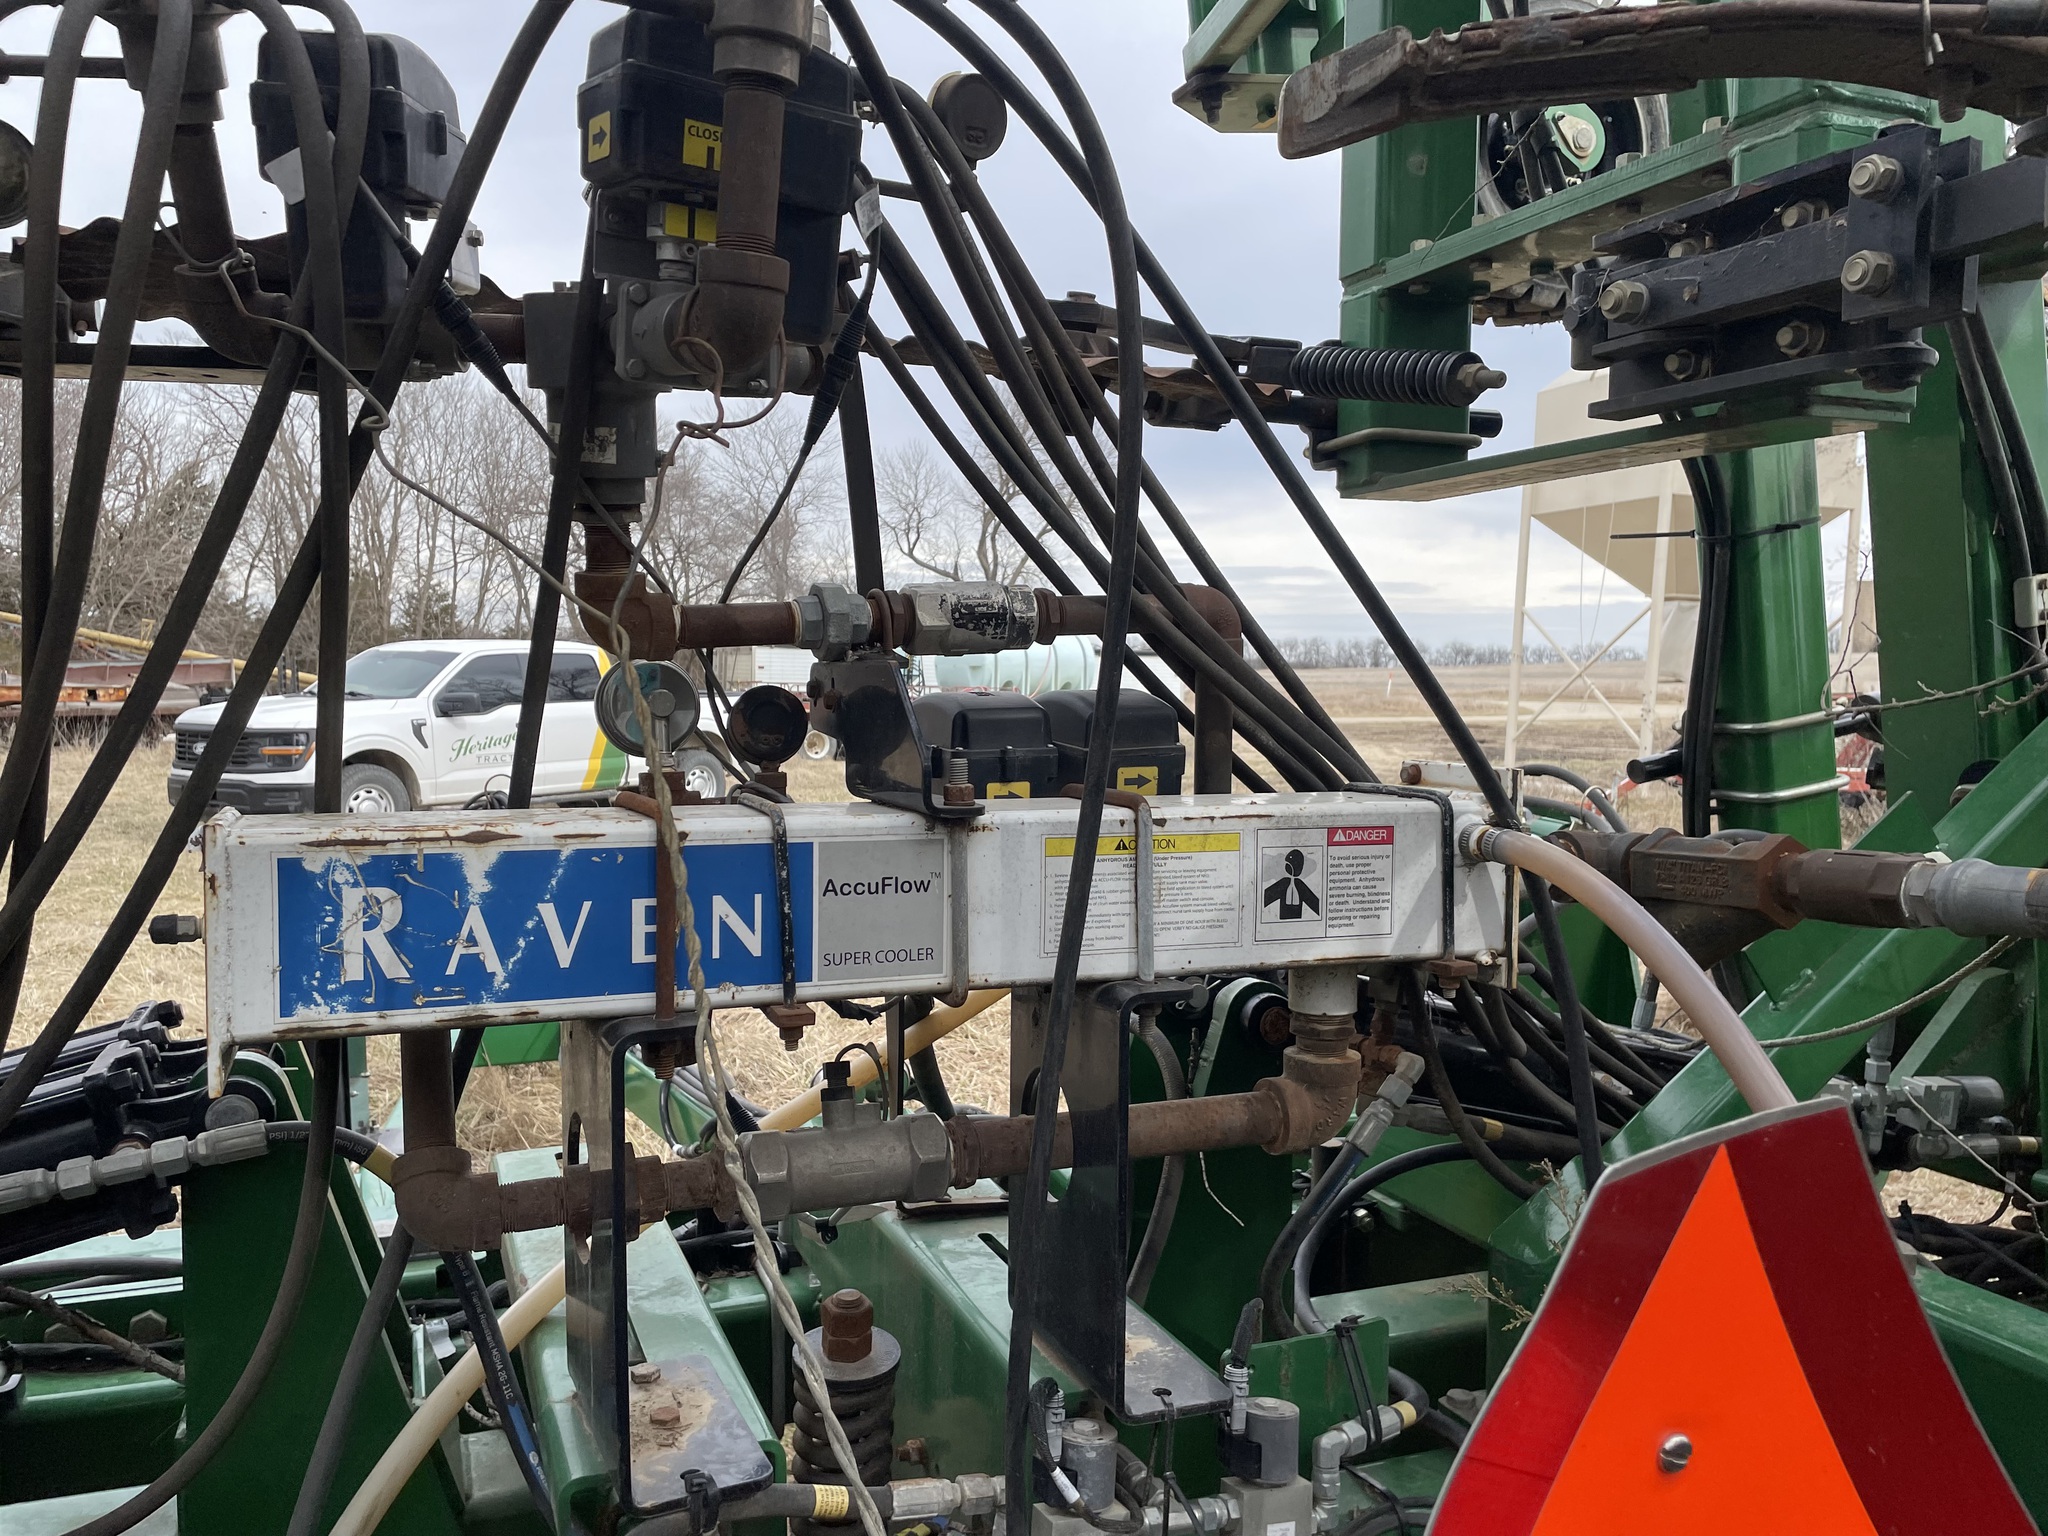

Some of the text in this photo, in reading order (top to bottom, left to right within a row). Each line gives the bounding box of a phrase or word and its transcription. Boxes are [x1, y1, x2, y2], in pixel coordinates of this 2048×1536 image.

[476, 754, 514, 763] TRACT
[1346, 830, 1386, 841] DANGER
[1128, 838, 1176, 850] CTION
[342, 887, 762, 981] RAVEN
[823, 948, 934, 967] SUPER COOLER
[470, 1290, 484, 1315] Flame
[478, 1314, 496, 1348] Resistant
[490, 1348, 501, 1371] MSHA
[498, 1370, 514, 1400] 2G-11C
